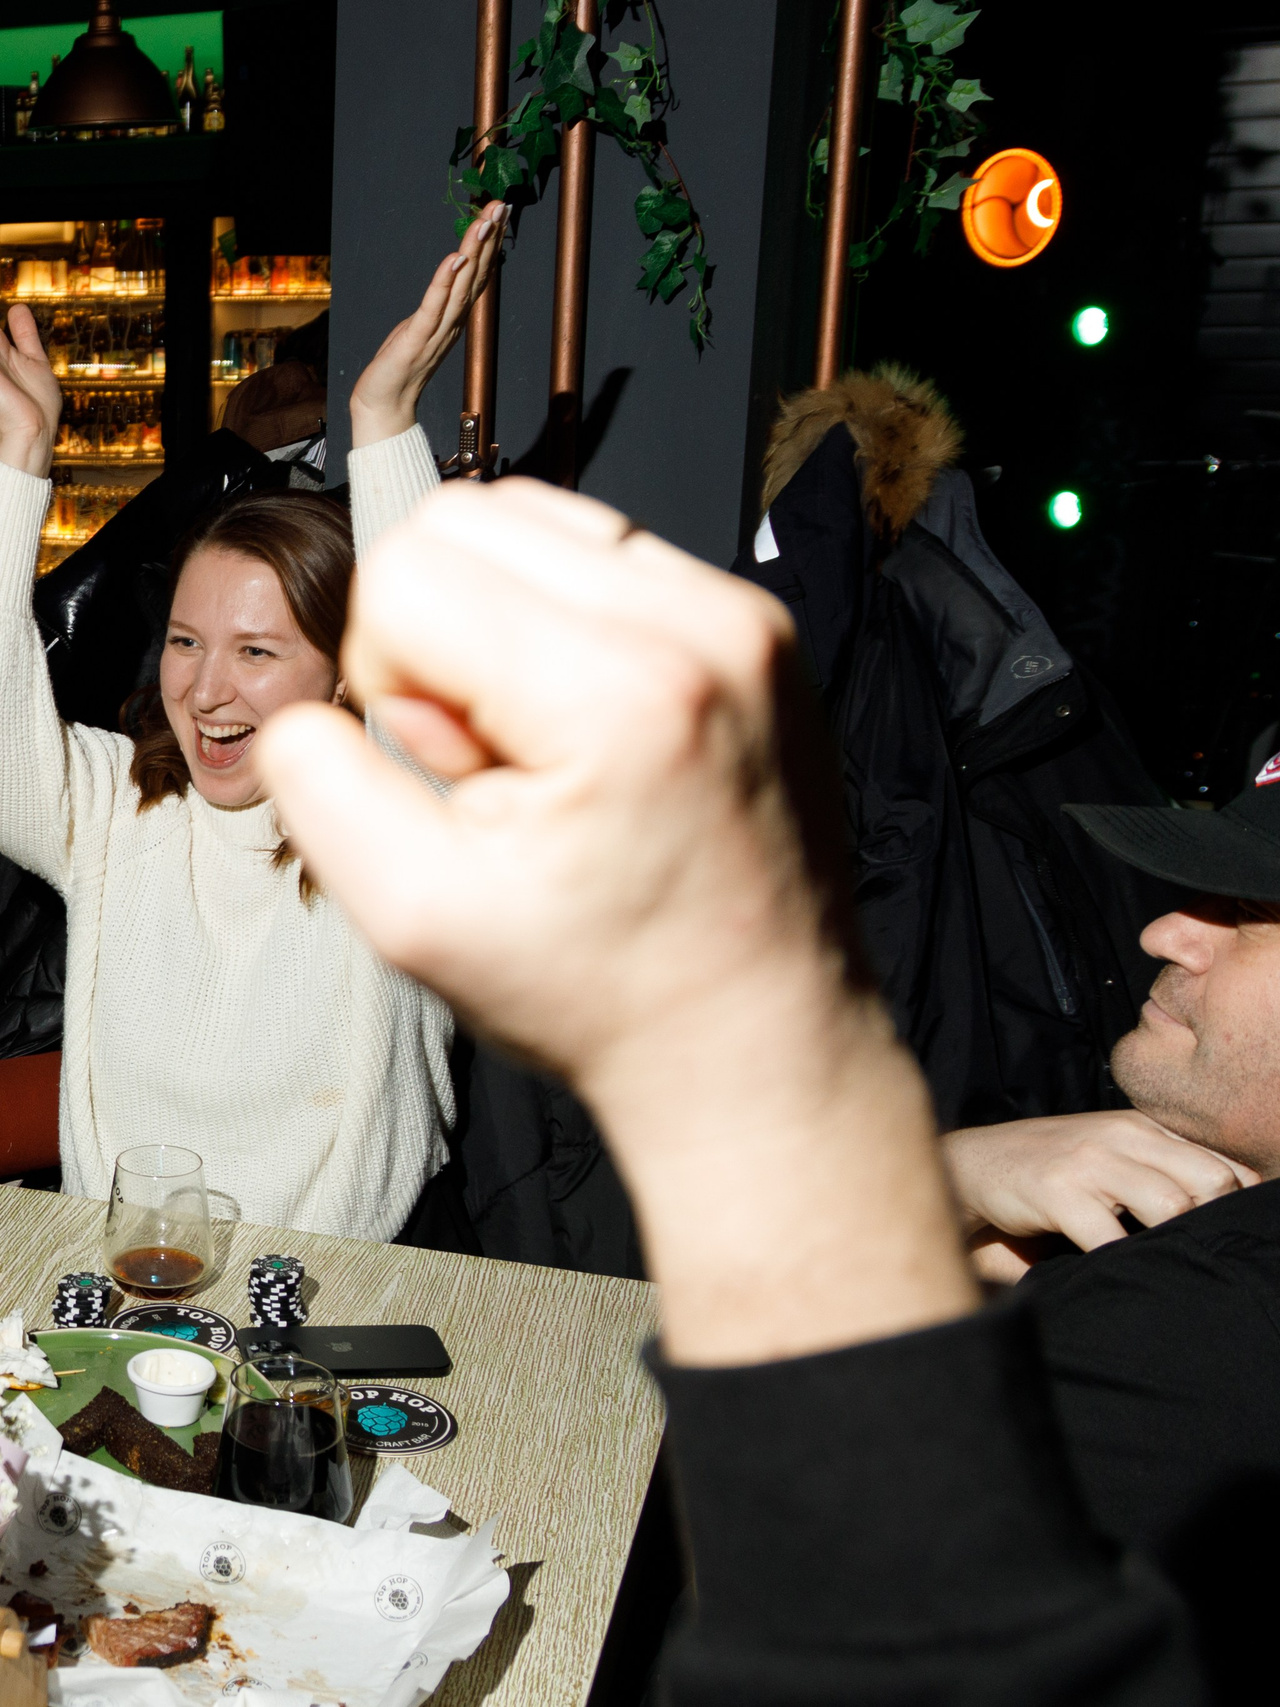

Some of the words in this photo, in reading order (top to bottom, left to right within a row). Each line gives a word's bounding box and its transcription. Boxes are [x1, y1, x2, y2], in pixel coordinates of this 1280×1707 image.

[177, 1308, 216, 1324] TOP
[207, 1326, 227, 1349] HOP
[351, 1390, 379, 1400] OP
[389, 1392, 437, 1413] HOP
[375, 1439, 411, 1448] CRAFT
[411, 1433, 432, 1444] BAR
[202, 1551, 211, 1568] TOP
[213, 1543, 232, 1551] HOP
[377, 1585, 386, 1603] TOP
[389, 1577, 408, 1586] HOP
